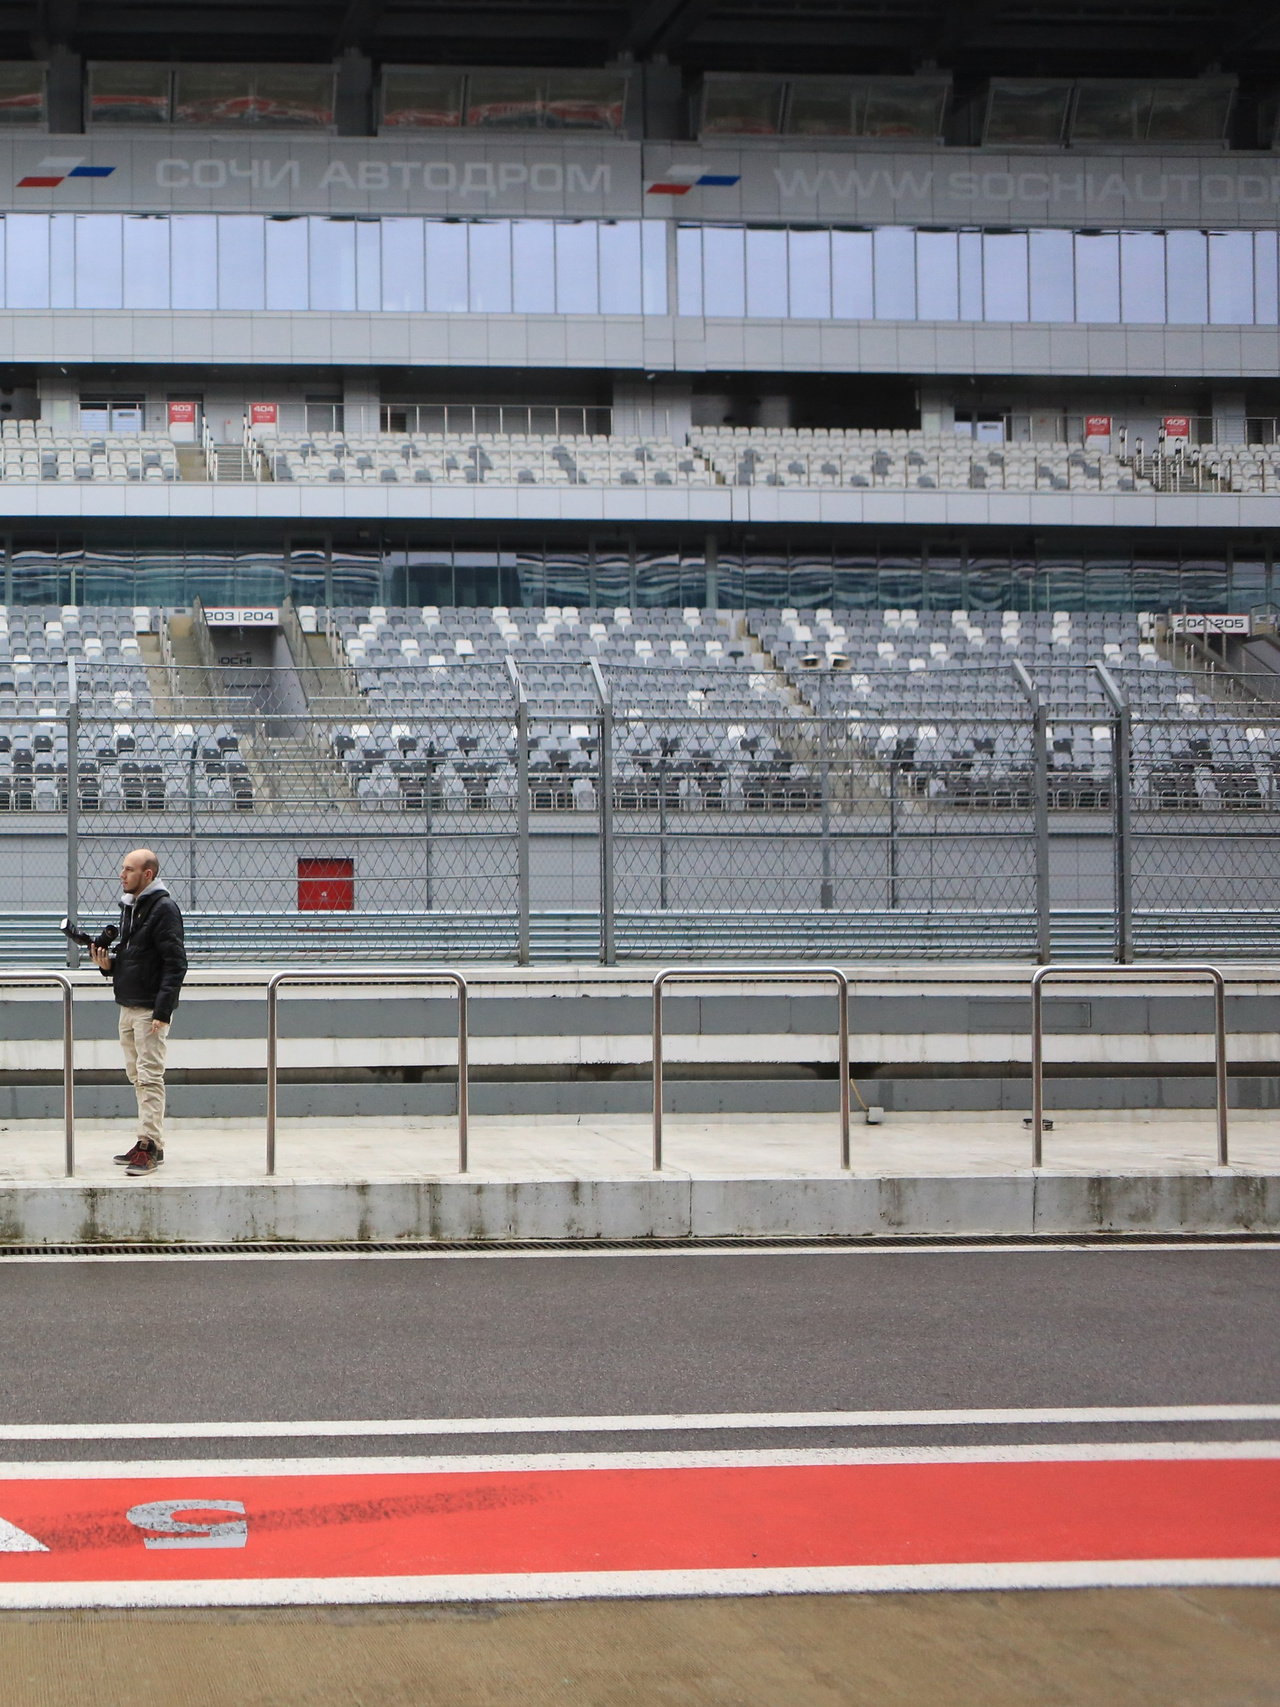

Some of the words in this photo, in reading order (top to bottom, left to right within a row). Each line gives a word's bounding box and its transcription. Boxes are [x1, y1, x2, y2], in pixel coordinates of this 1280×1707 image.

[155, 158, 300, 189] СОЧИ
[319, 159, 612, 197] АВТОДРОМ
[773, 167, 1280, 202] WWW.SOCHIAUTOD
[171, 404, 192, 412] 403
[1088, 417, 1108, 426] 404
[1166, 418, 1187, 426] 405
[205, 611, 235, 621] 203
[243, 611, 274, 621] 204
[1215, 618, 1244, 628] 205
[126, 1499, 248, 1550] 5
